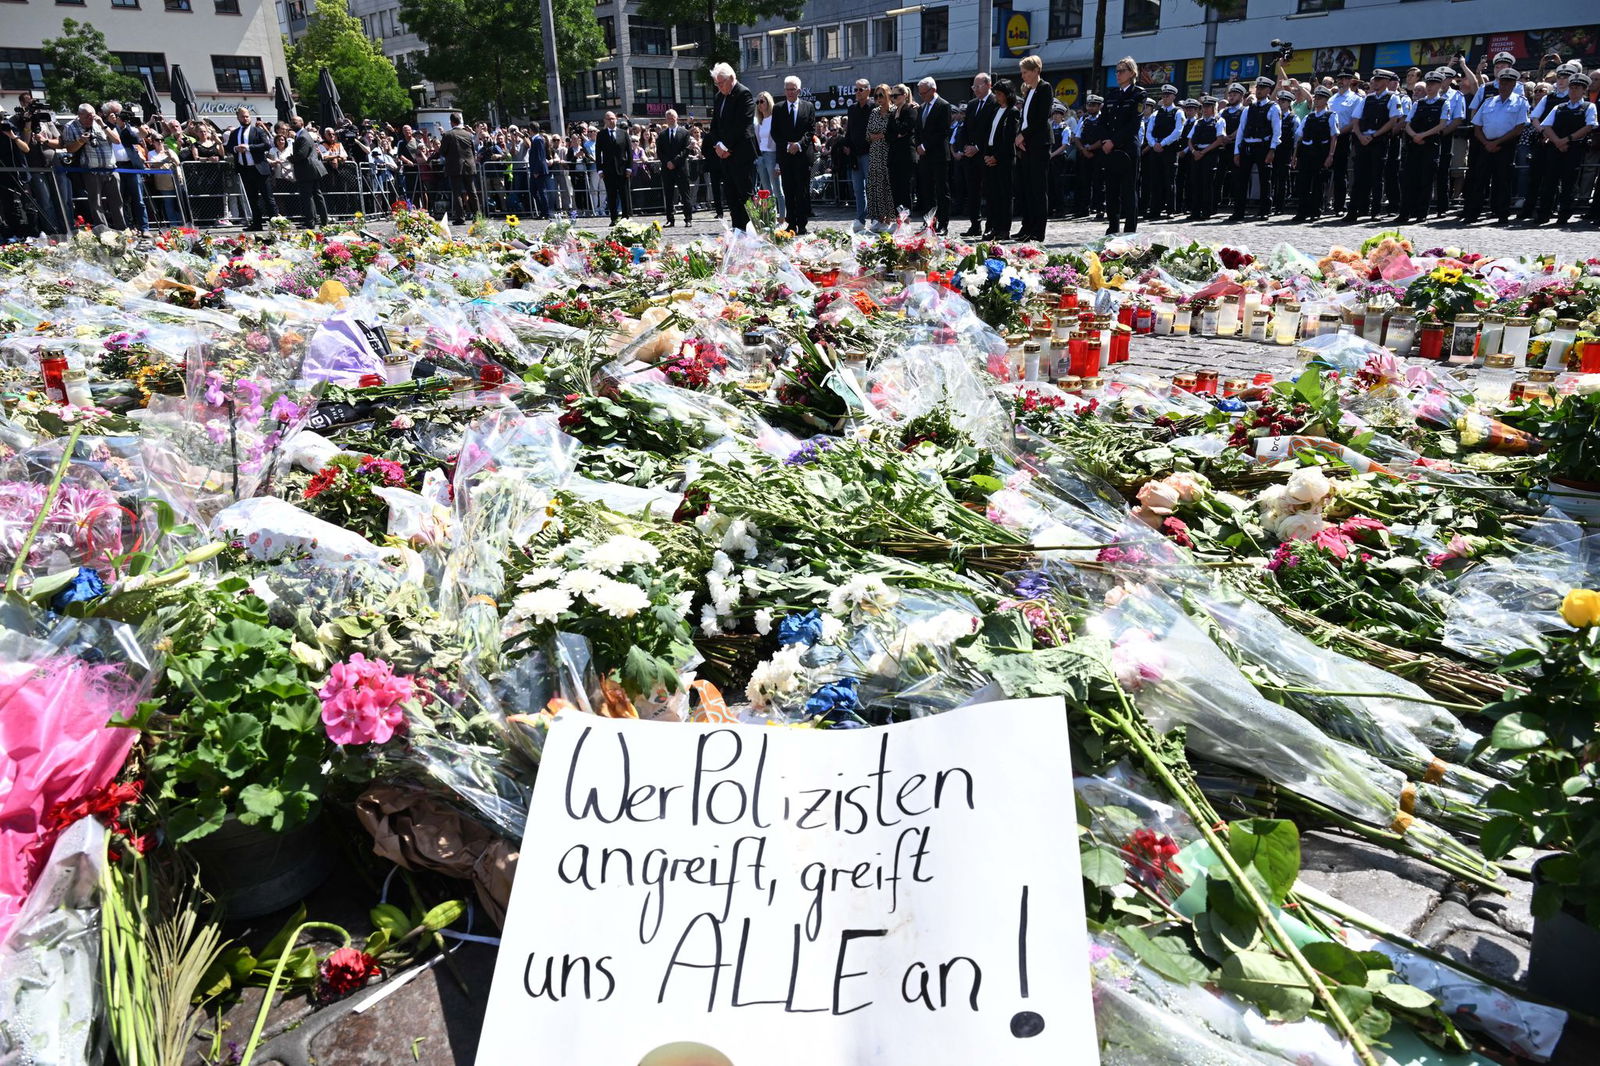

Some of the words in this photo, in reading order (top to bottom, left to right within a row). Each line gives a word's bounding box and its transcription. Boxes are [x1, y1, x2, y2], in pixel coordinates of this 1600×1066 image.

[564, 726, 685, 823] Wer
[692, 729, 974, 835] Polizisten
[557, 835, 778, 945] angreift,
[800, 826, 936, 942] greift
[523, 951, 616, 1003] uns
[657, 912, 889, 1016] ALLE
